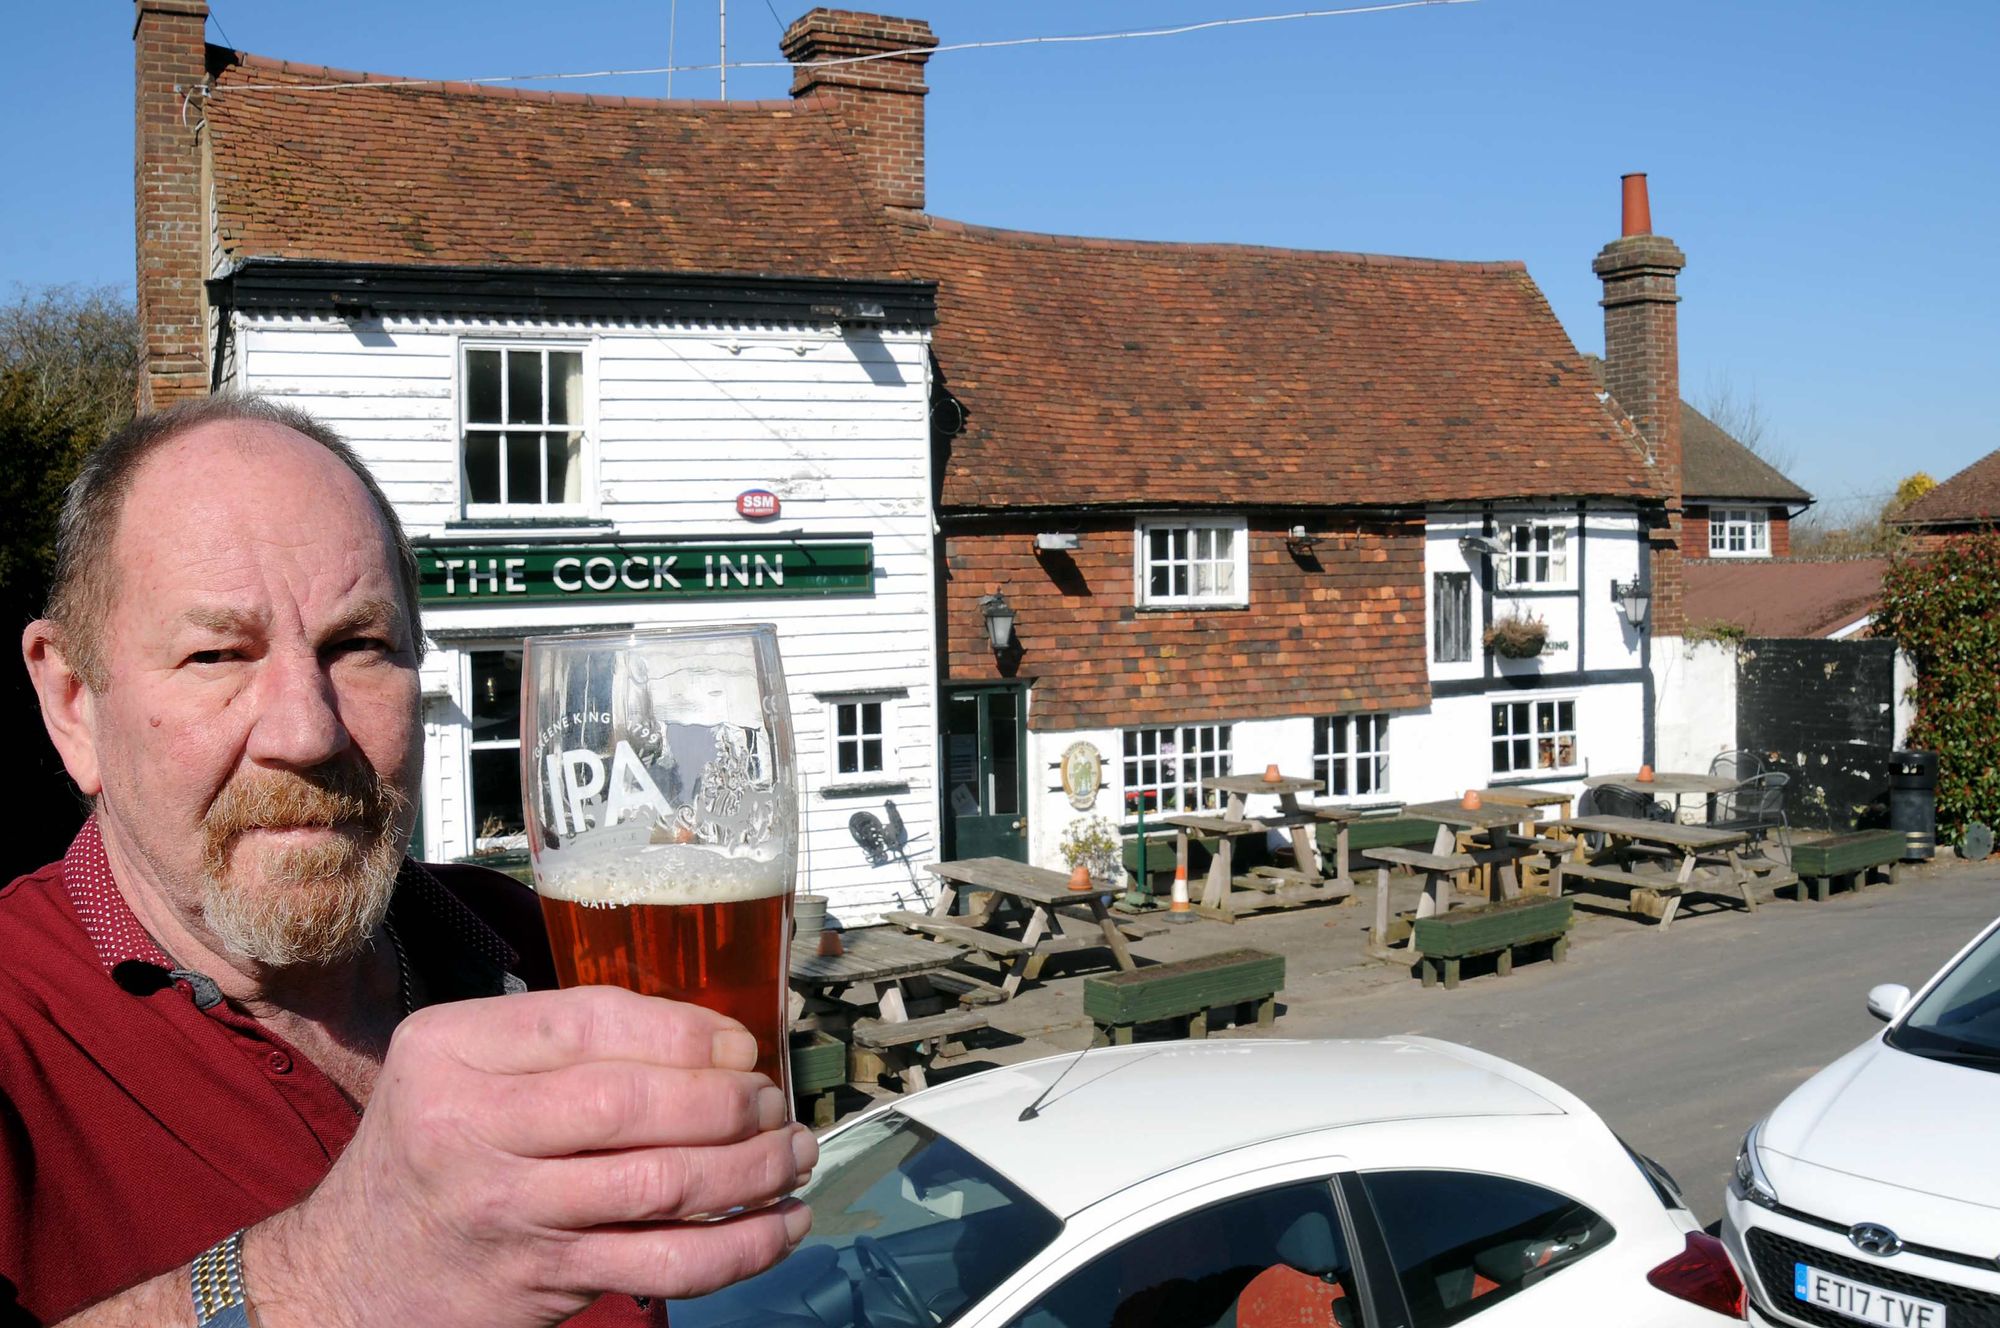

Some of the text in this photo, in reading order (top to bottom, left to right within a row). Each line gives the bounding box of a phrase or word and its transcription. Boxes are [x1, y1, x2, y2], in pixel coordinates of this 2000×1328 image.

[743, 495, 775, 508] SSM
[435, 553, 784, 594] THE COCK INN
[1545, 640, 1568, 650] KING
[534, 711, 611, 758] GREENE KING
[627, 720, 660, 744] 1799
[546, 740, 674, 836] IPA
[1816, 1275, 1871, 1316] ET17
